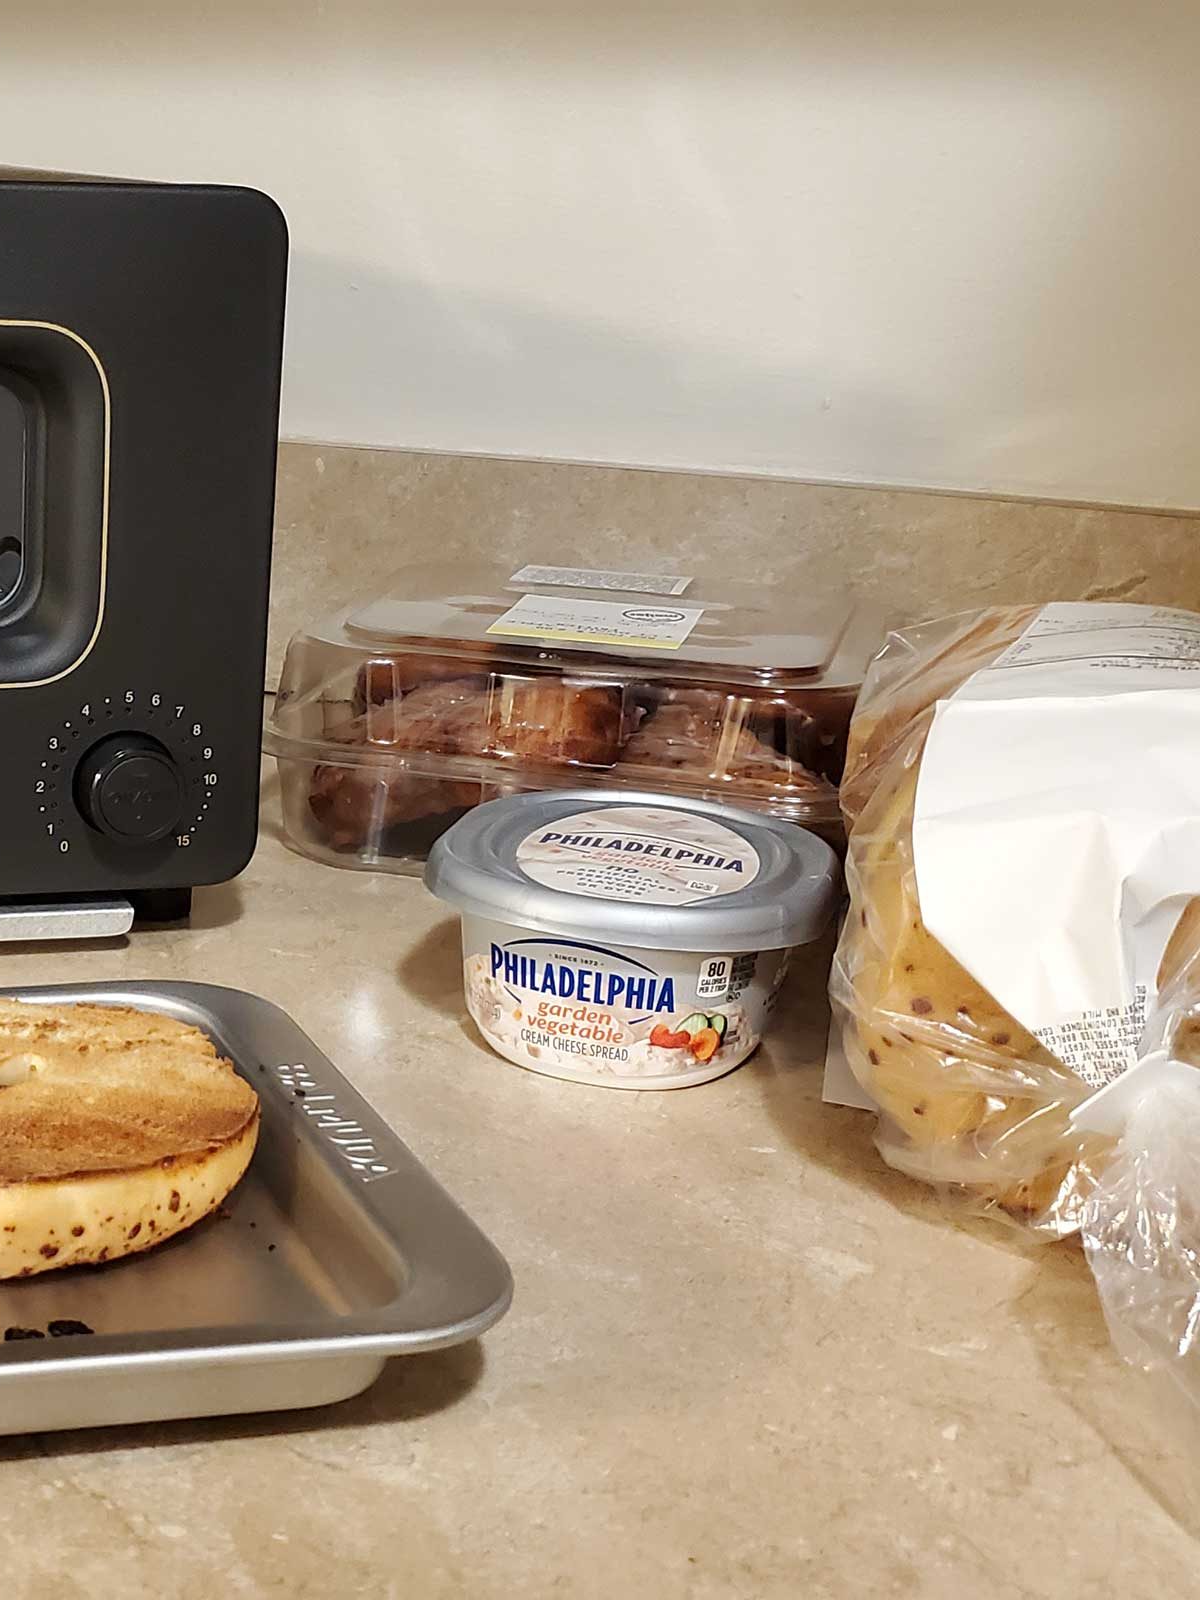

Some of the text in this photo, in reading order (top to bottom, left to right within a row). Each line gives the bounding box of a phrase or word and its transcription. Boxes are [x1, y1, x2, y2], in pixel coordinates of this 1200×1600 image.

[125, 691, 134, 703] 5
[151, 694, 160, 706] 6
[81, 704, 90, 716] 4
[175, 706, 184, 718] 7
[193, 724, 201, 736] 8
[49, 738, 58, 749] 3
[203, 747, 212, 759] 9
[203, 773, 217, 785] 10
[35, 781, 45, 793] 2
[47, 823, 54, 835] 1
[60, 840, 69, 852] 0
[176, 835, 190, 847] 15
[539, 832, 744, 873] PHILADELPHIA
[554, 954, 577, 963] SINCE
[708, 961, 726, 977] 80
[490, 942, 675, 1014] PHILADELPHIA
[701, 977, 728, 986] CALORIES
[537, 1002, 612, 1026] garden
[527, 1015, 624, 1044] vegetable
[521, 1028, 629, 1061] CREAM CHEESE SPREAD
[277, 1064, 398, 1182] BALMUDA
